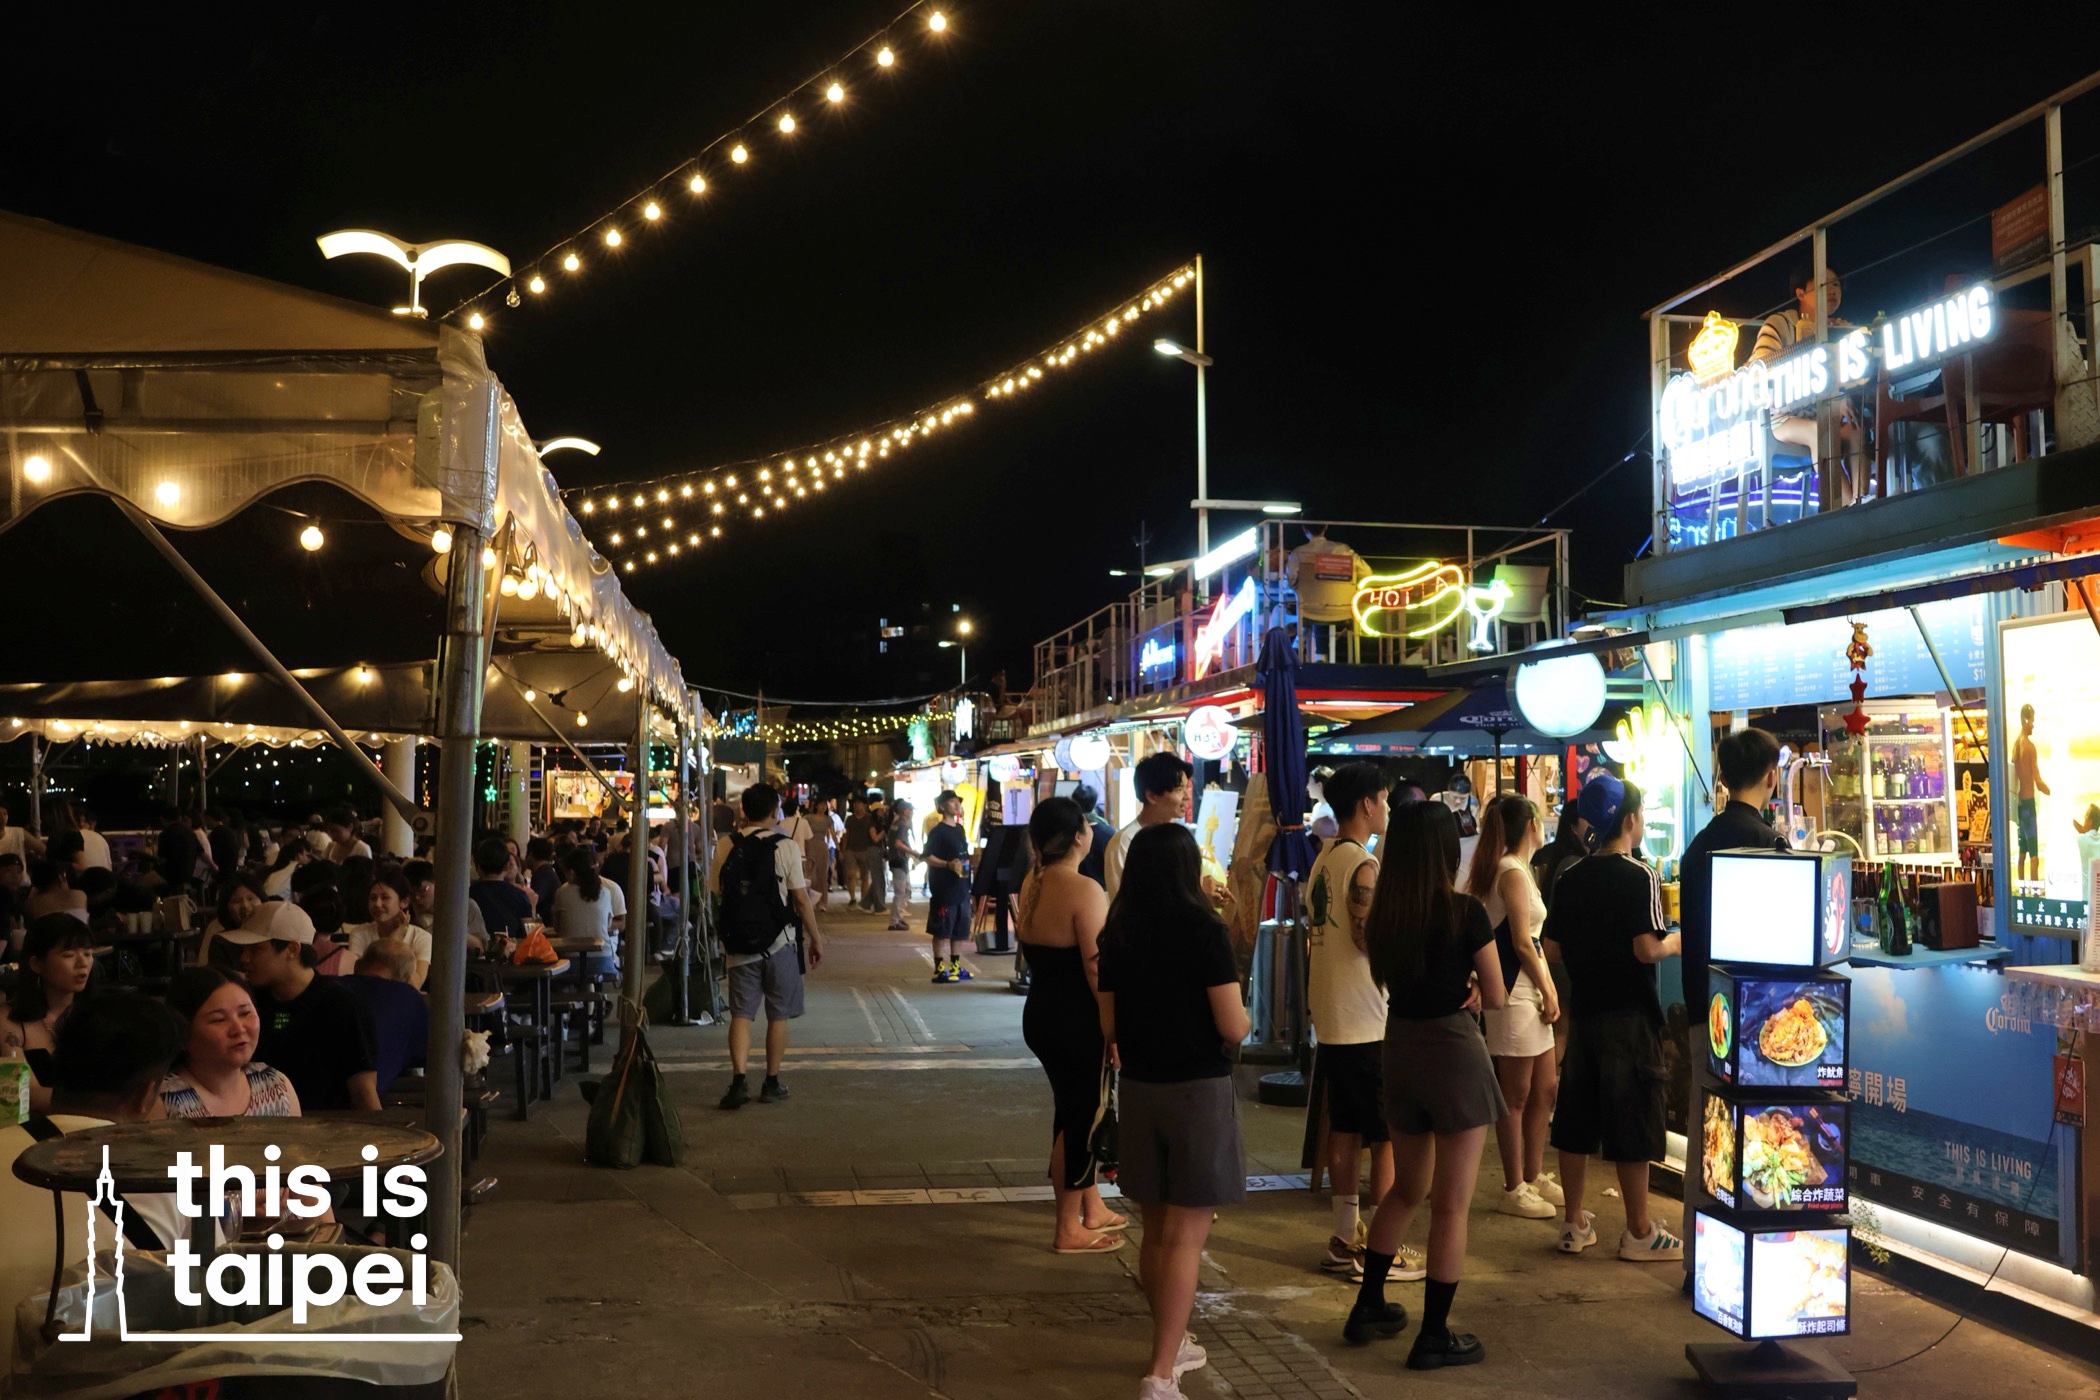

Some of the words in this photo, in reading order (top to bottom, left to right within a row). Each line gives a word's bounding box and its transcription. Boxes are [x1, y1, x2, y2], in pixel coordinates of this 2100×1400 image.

[1770, 347, 1828, 409] THIS
[1839, 332, 1870, 384] IS
[1883, 286, 1993, 371] LIVING
[1370, 586, 1414, 606] HOT
[1421, 576, 1449, 599] LA
[1985, 1007, 2031, 1035] Corona
[1944, 1141, 1970, 1164] THIS
[1976, 1147, 1986, 1168] IS
[1991, 1152, 2032, 1180] LIVING
